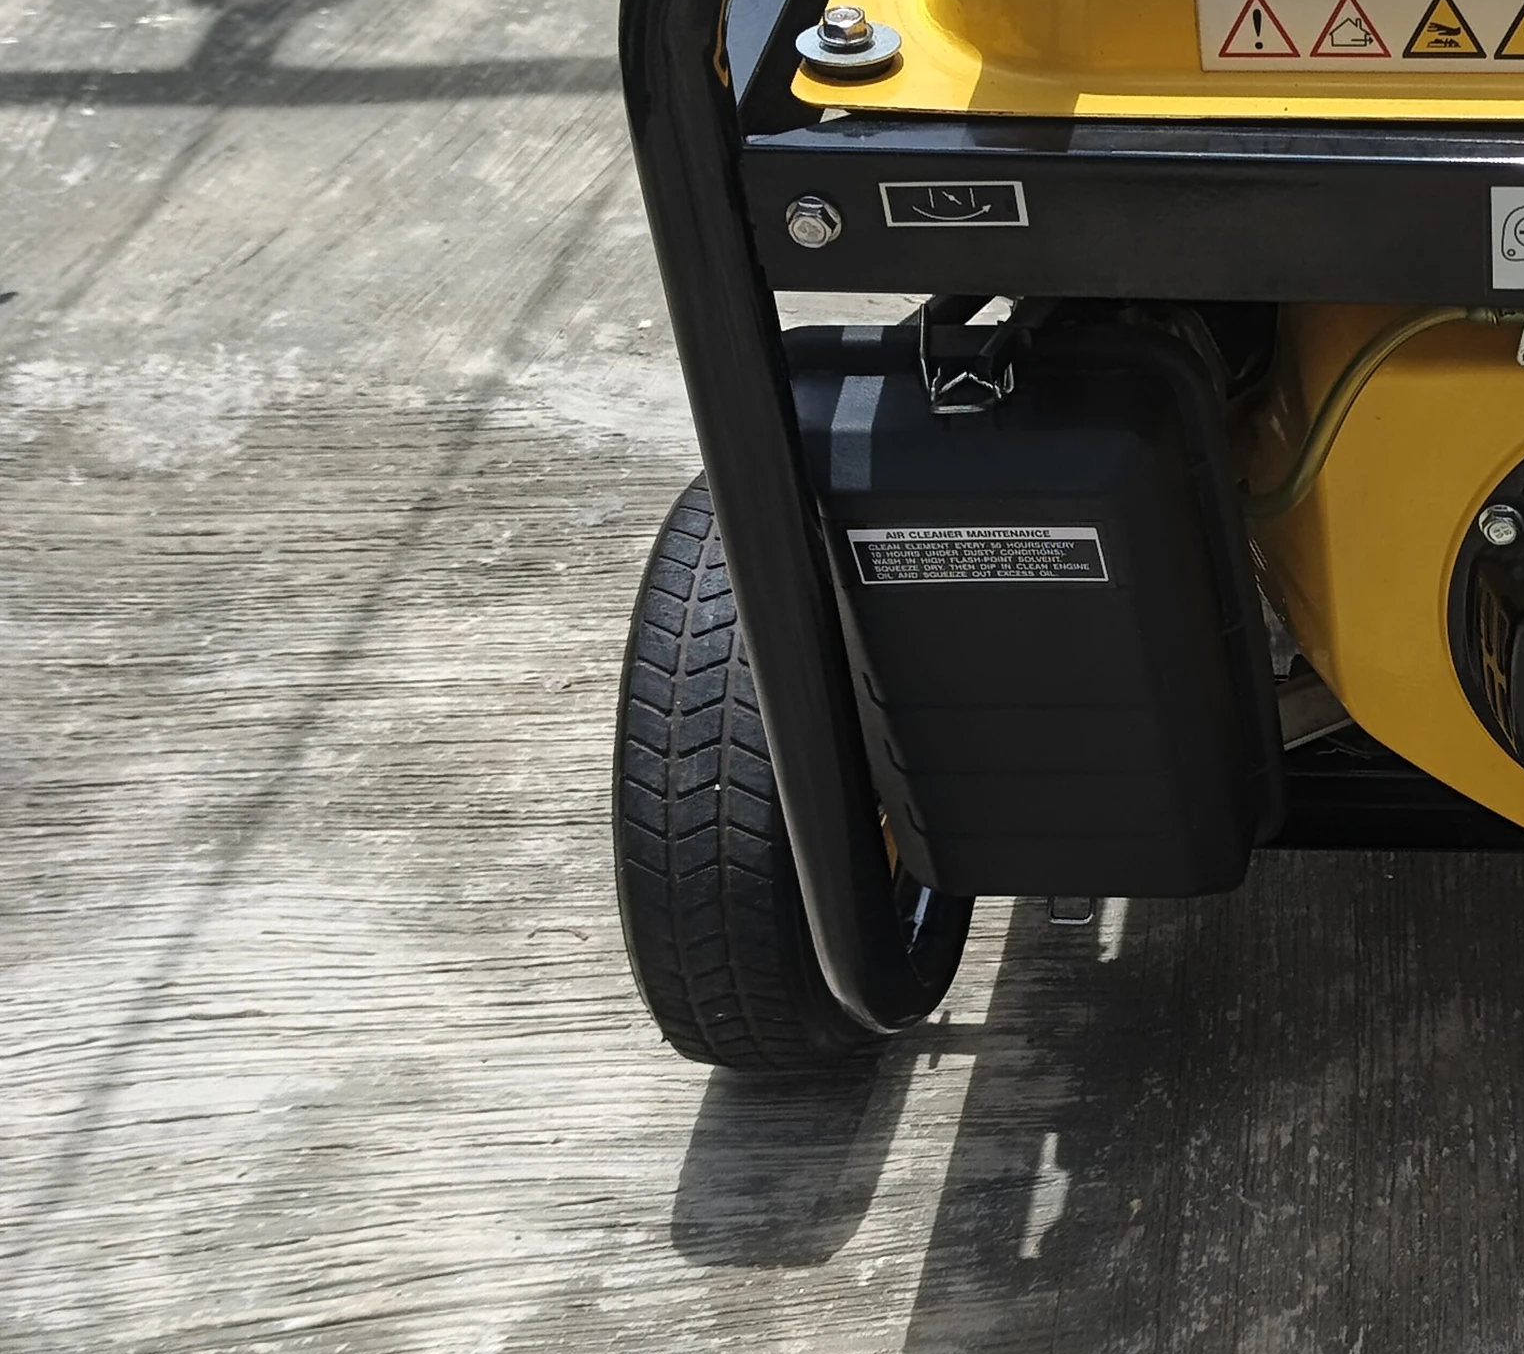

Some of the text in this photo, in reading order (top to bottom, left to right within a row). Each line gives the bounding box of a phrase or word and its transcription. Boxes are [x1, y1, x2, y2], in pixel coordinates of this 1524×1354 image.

[886, 530, 1051, 539] AIR CLEANER MAINTENANCE
[868, 543, 900, 551] CLEAN
[955, 542, 985, 550] EVERY
